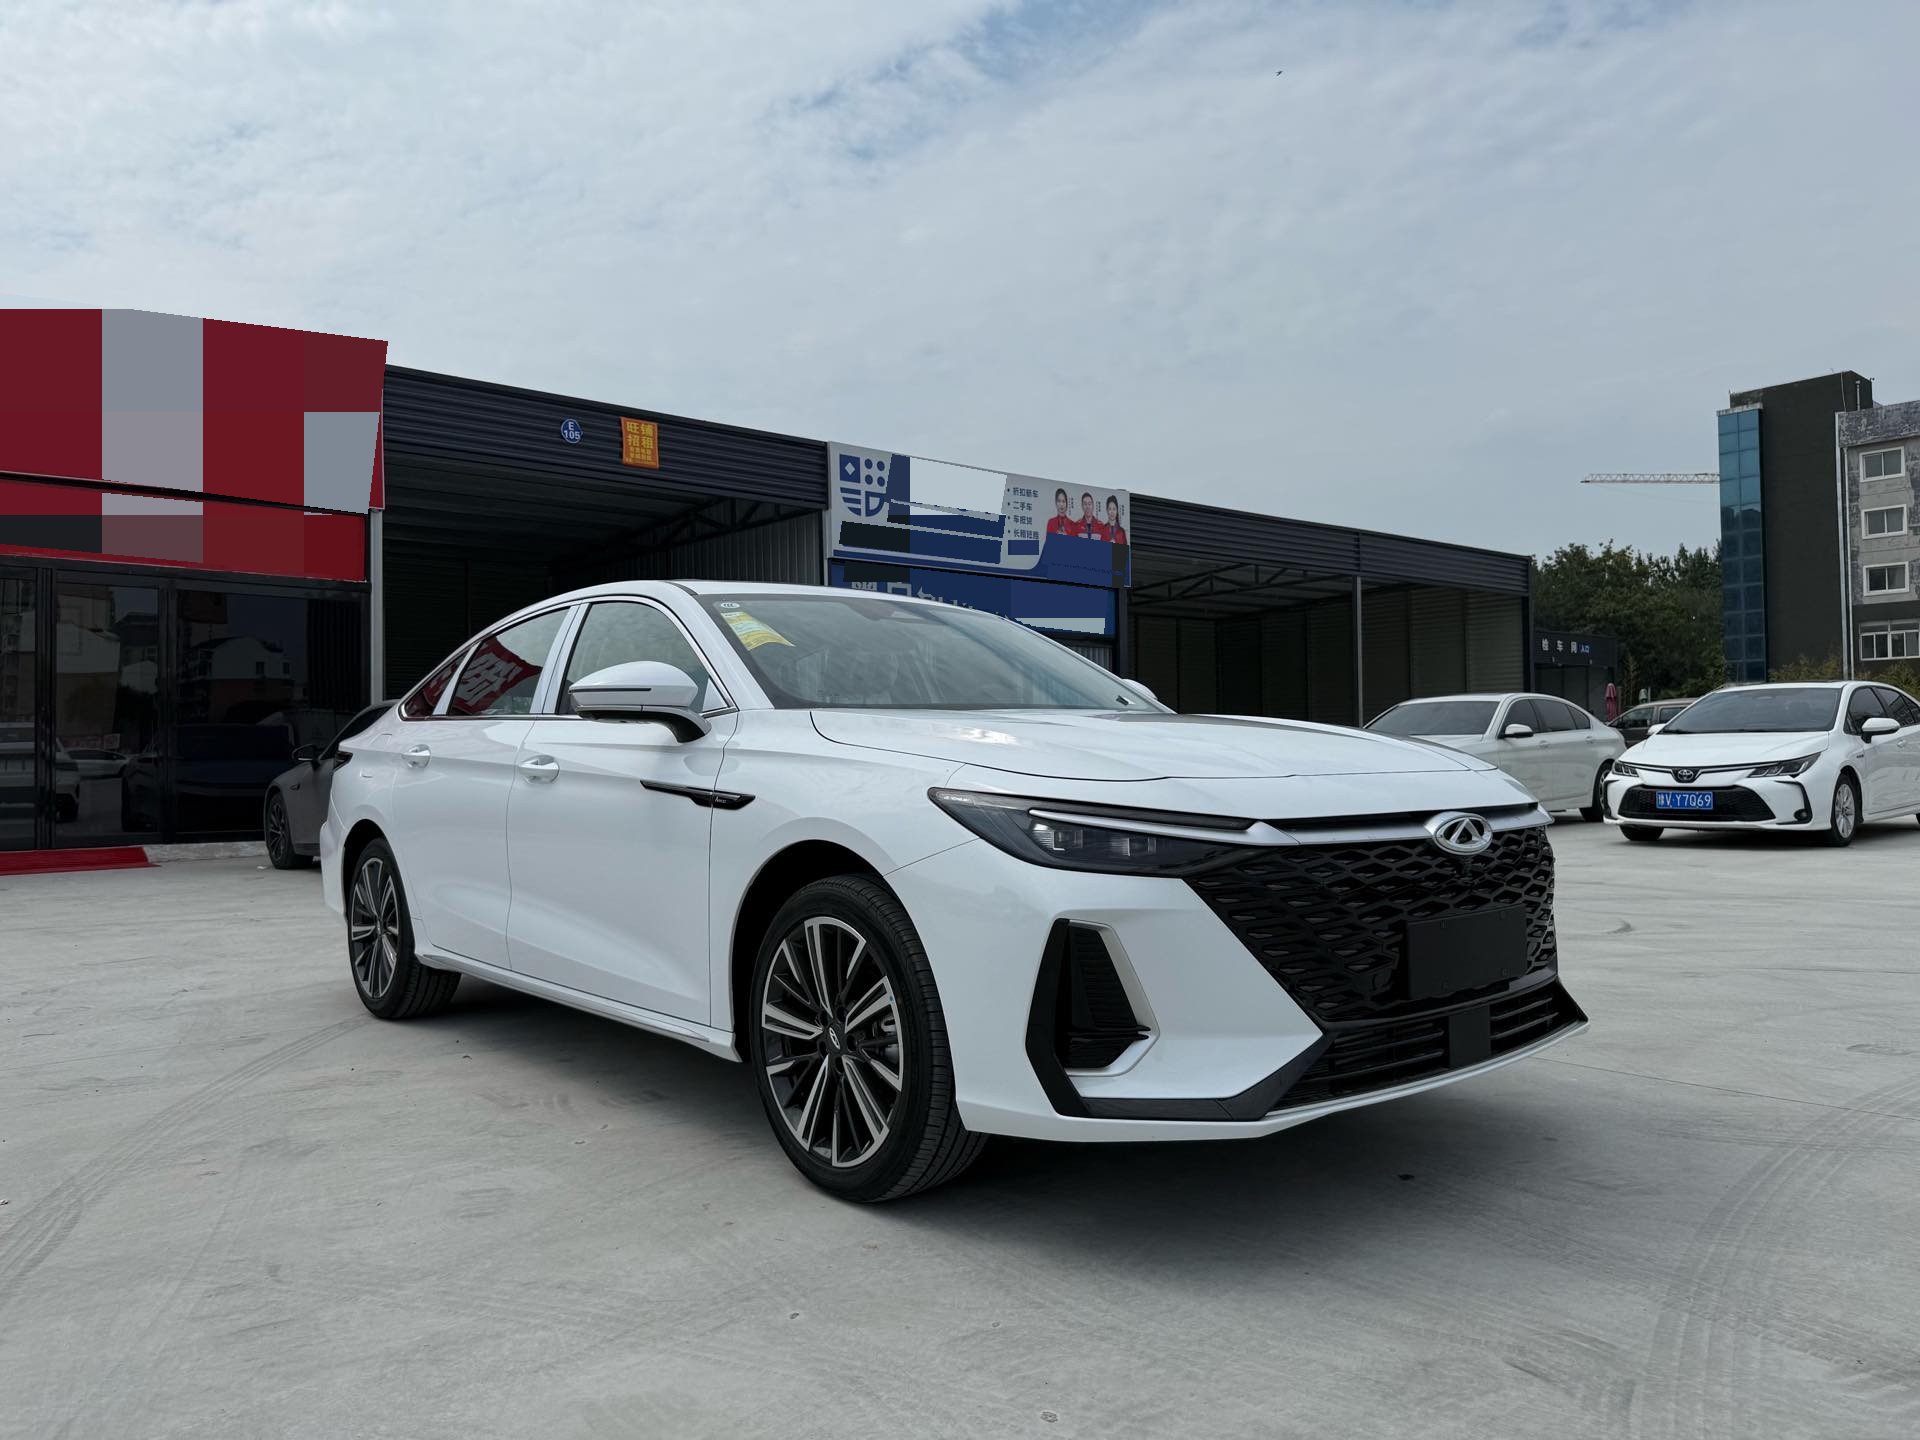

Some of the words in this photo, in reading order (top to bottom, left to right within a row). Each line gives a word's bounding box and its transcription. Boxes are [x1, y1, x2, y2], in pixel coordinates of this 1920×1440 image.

[568, 421, 574, 431] E
[564, 430, 580, 440] 105
[627, 433, 653, 449] 招租
[1013, 501, 1032, 511] 二手车
